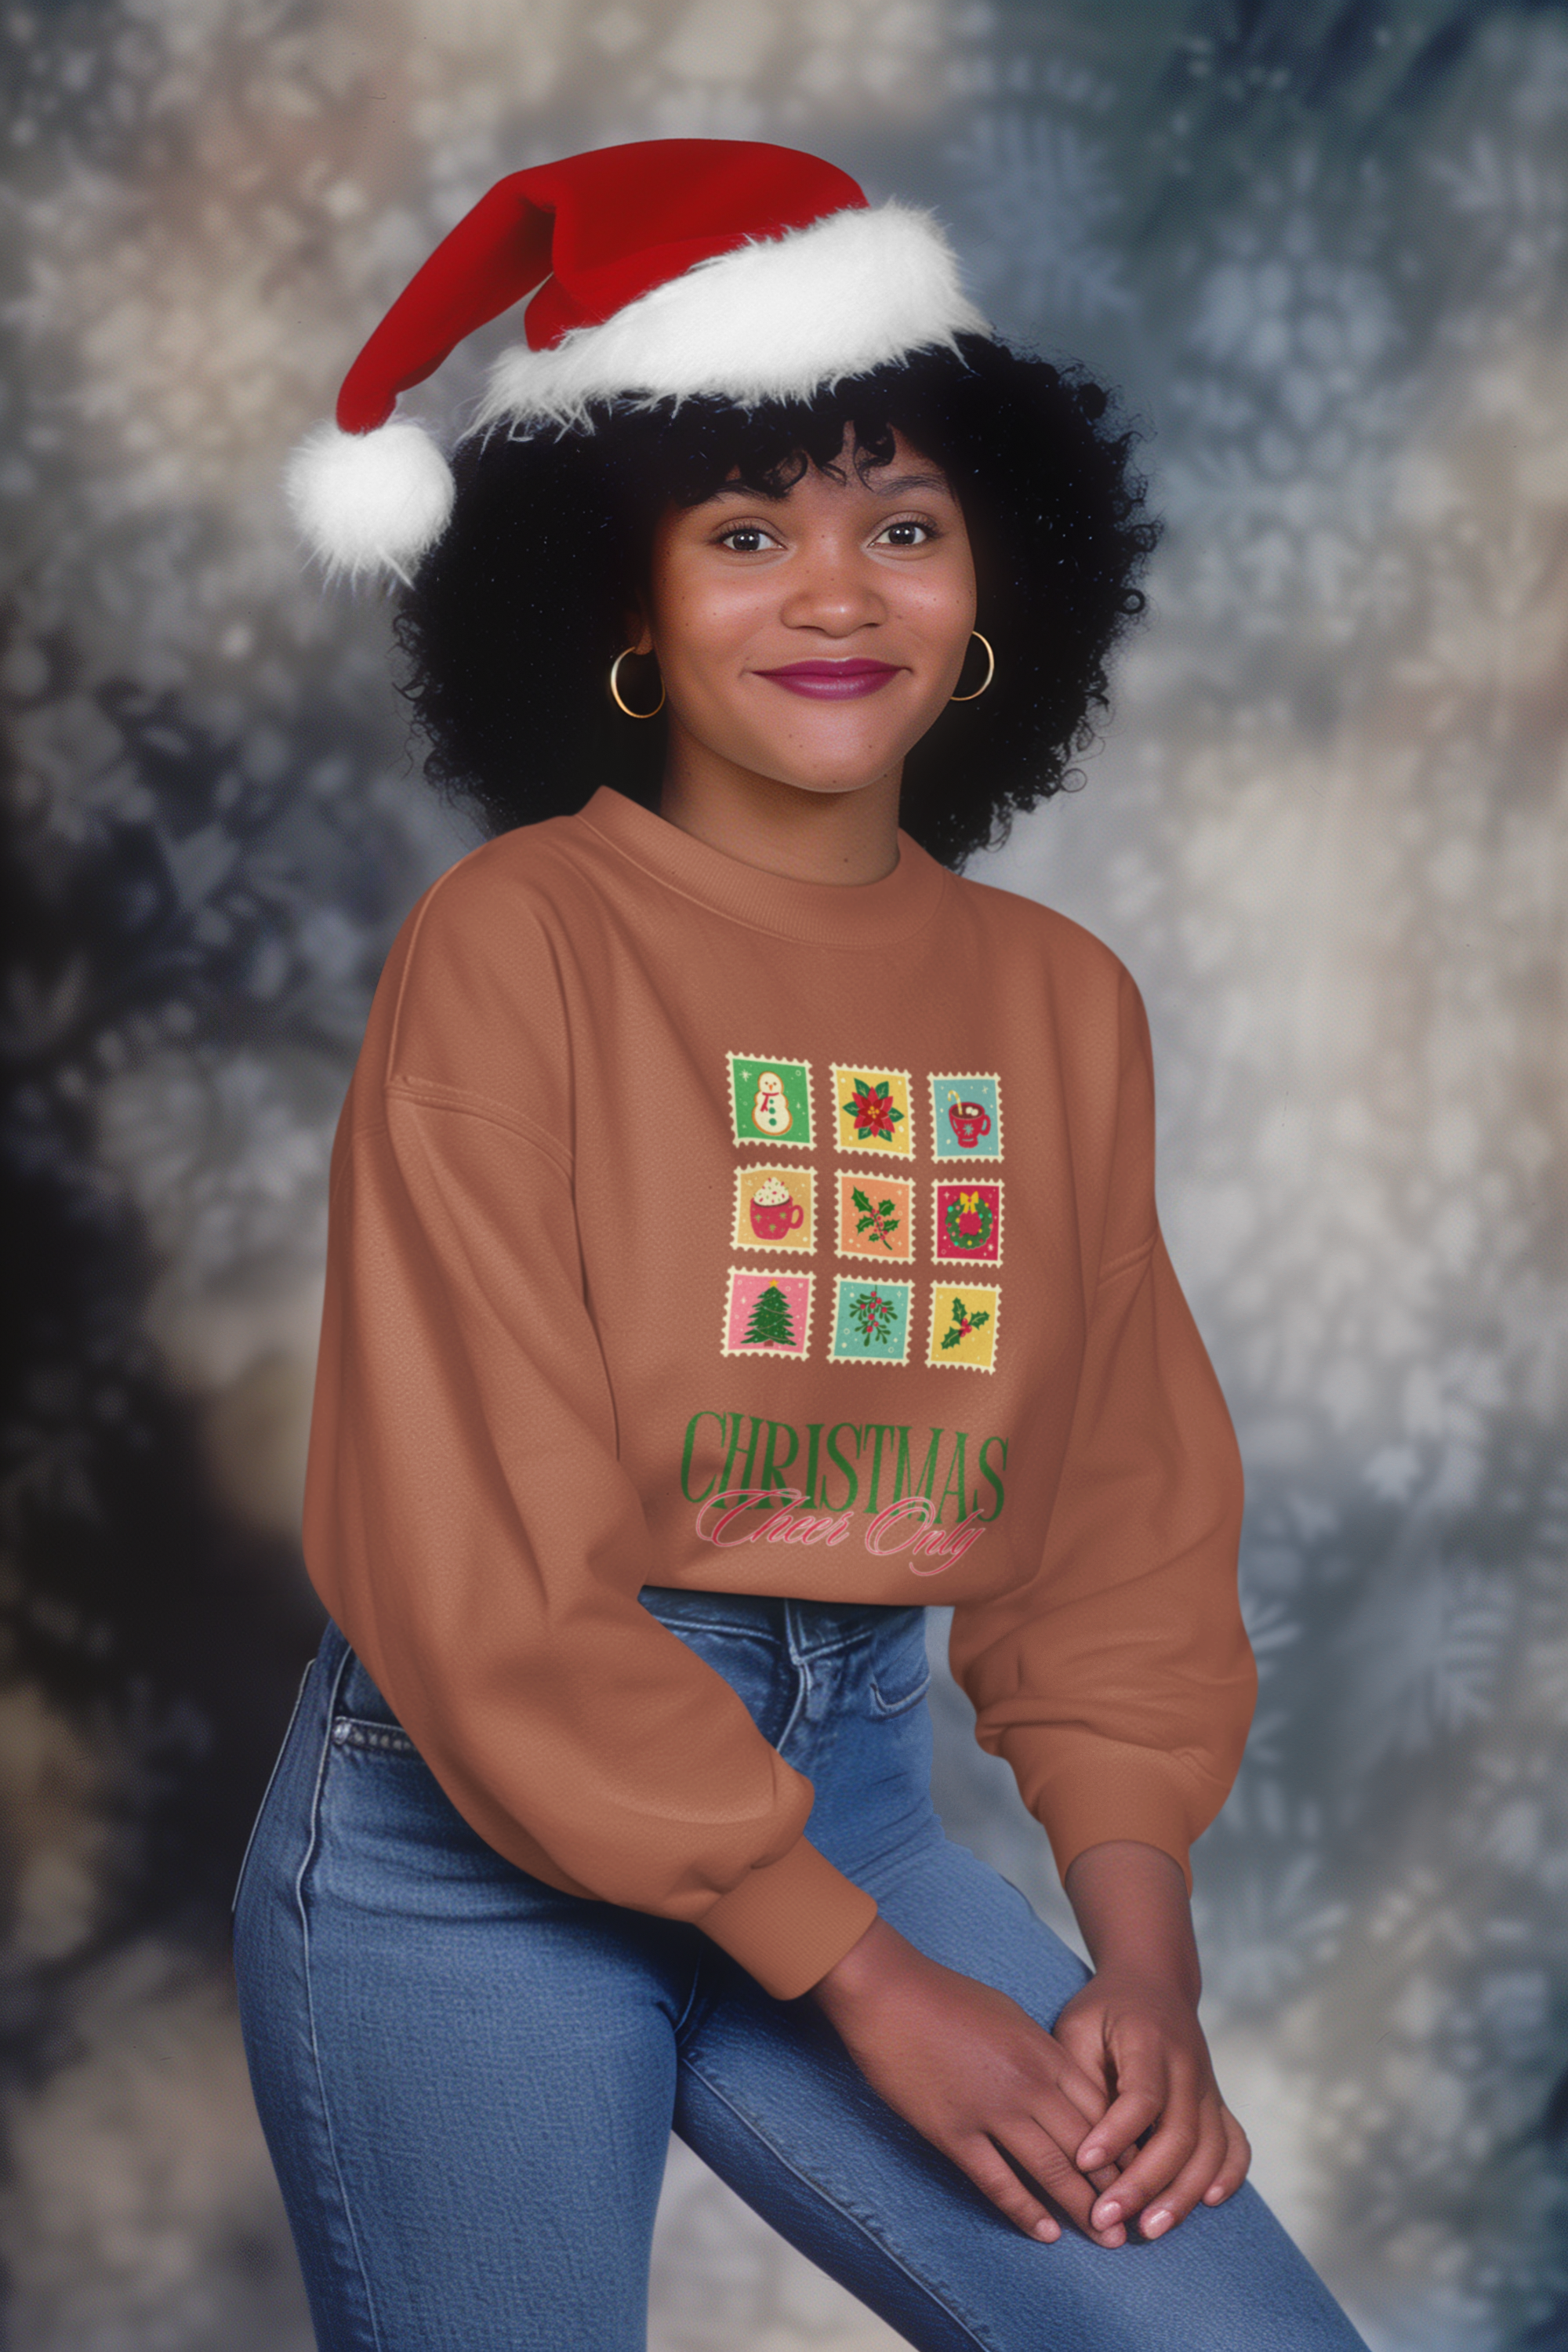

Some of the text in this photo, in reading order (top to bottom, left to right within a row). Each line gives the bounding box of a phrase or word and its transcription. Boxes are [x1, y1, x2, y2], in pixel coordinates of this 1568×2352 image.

[681, 1410, 1009, 1524] CHRISTMAS
[696, 1488, 985, 1576] Cheer Only
